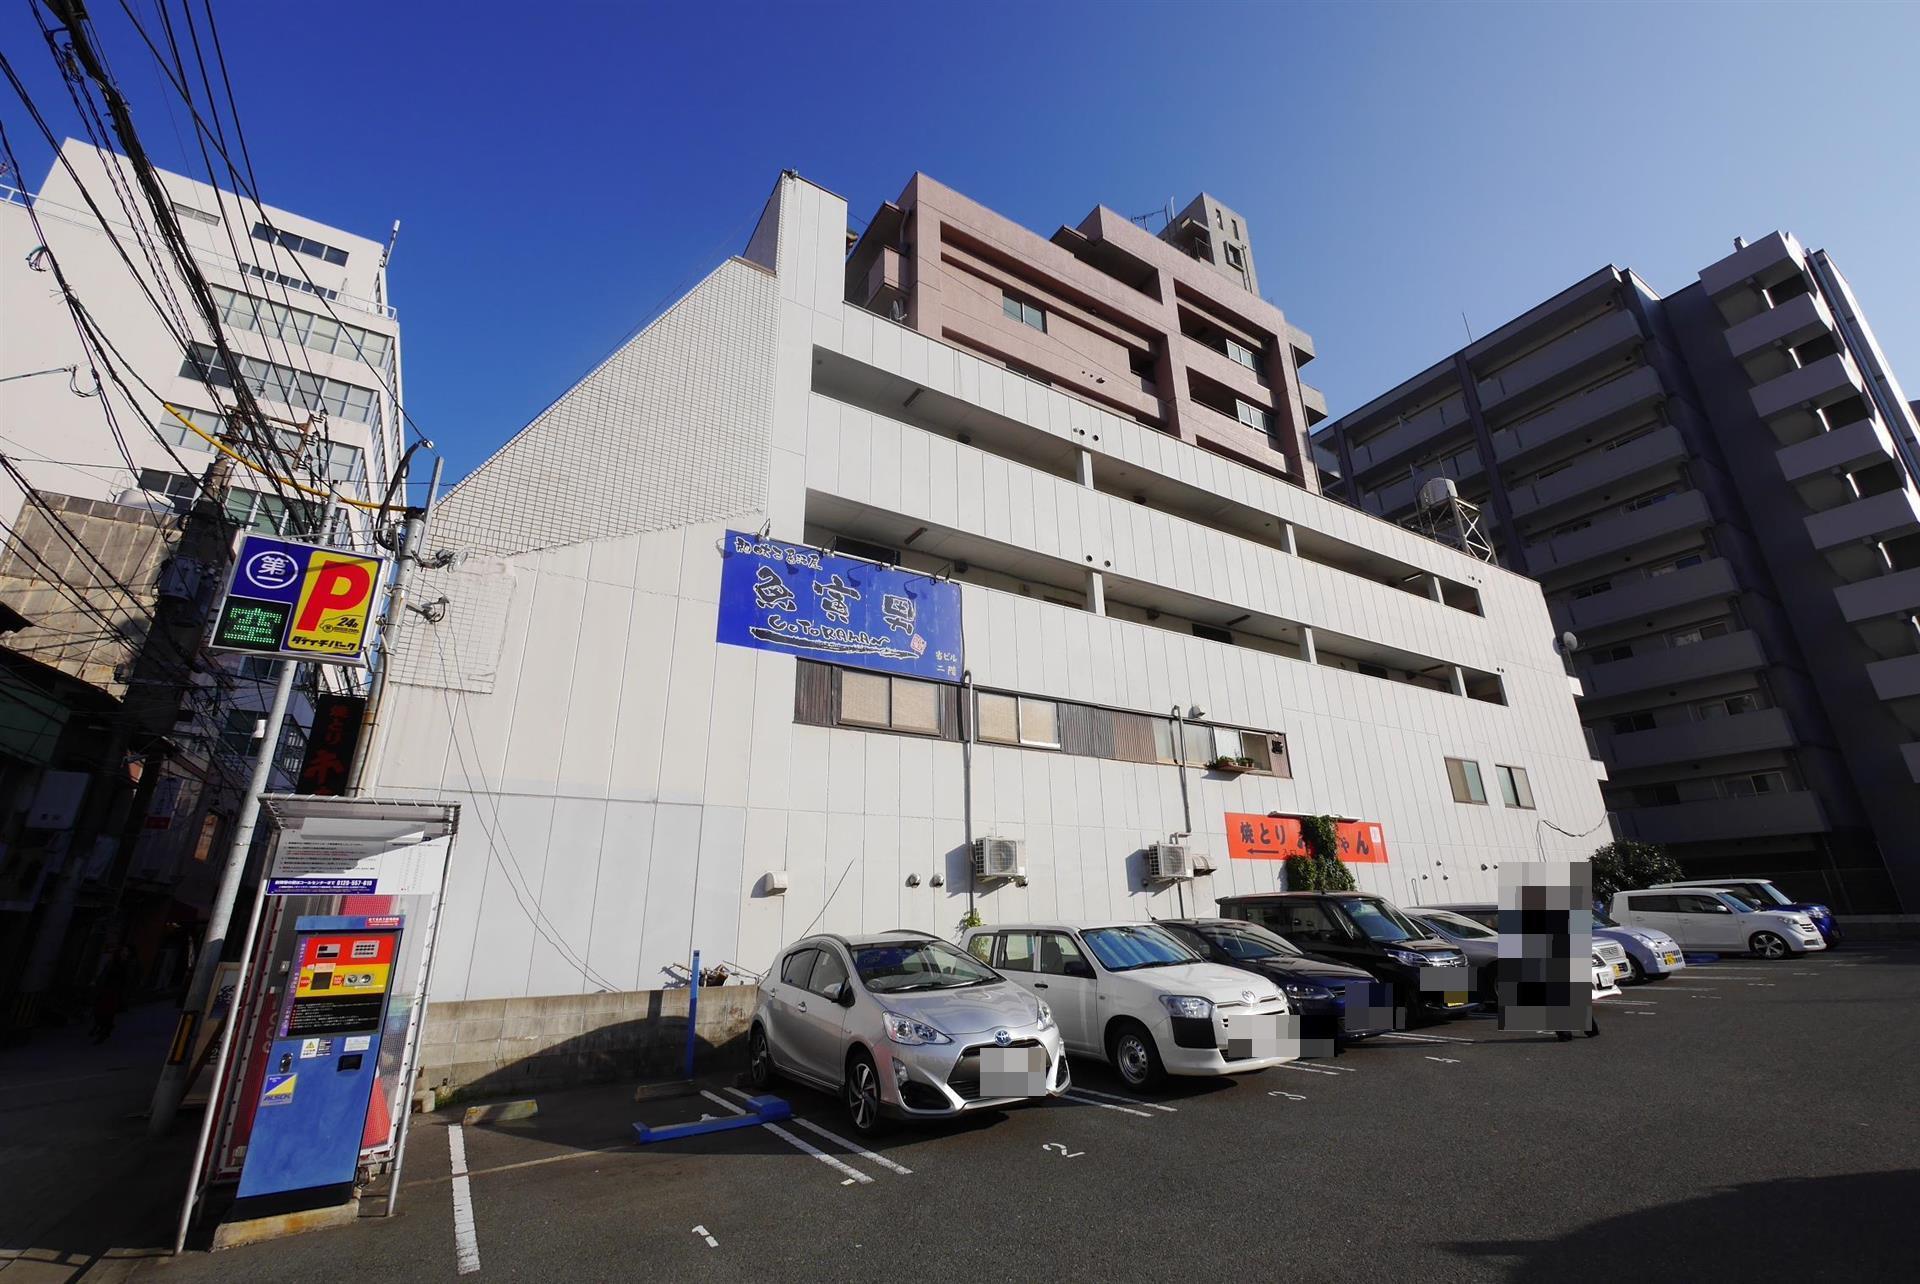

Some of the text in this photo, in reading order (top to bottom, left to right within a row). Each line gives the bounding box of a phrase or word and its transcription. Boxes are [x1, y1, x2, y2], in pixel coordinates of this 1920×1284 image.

[296, 560, 370, 632] P
[224, 607, 282, 644] 空
[1240, 821, 1286, 845] 焼とり
